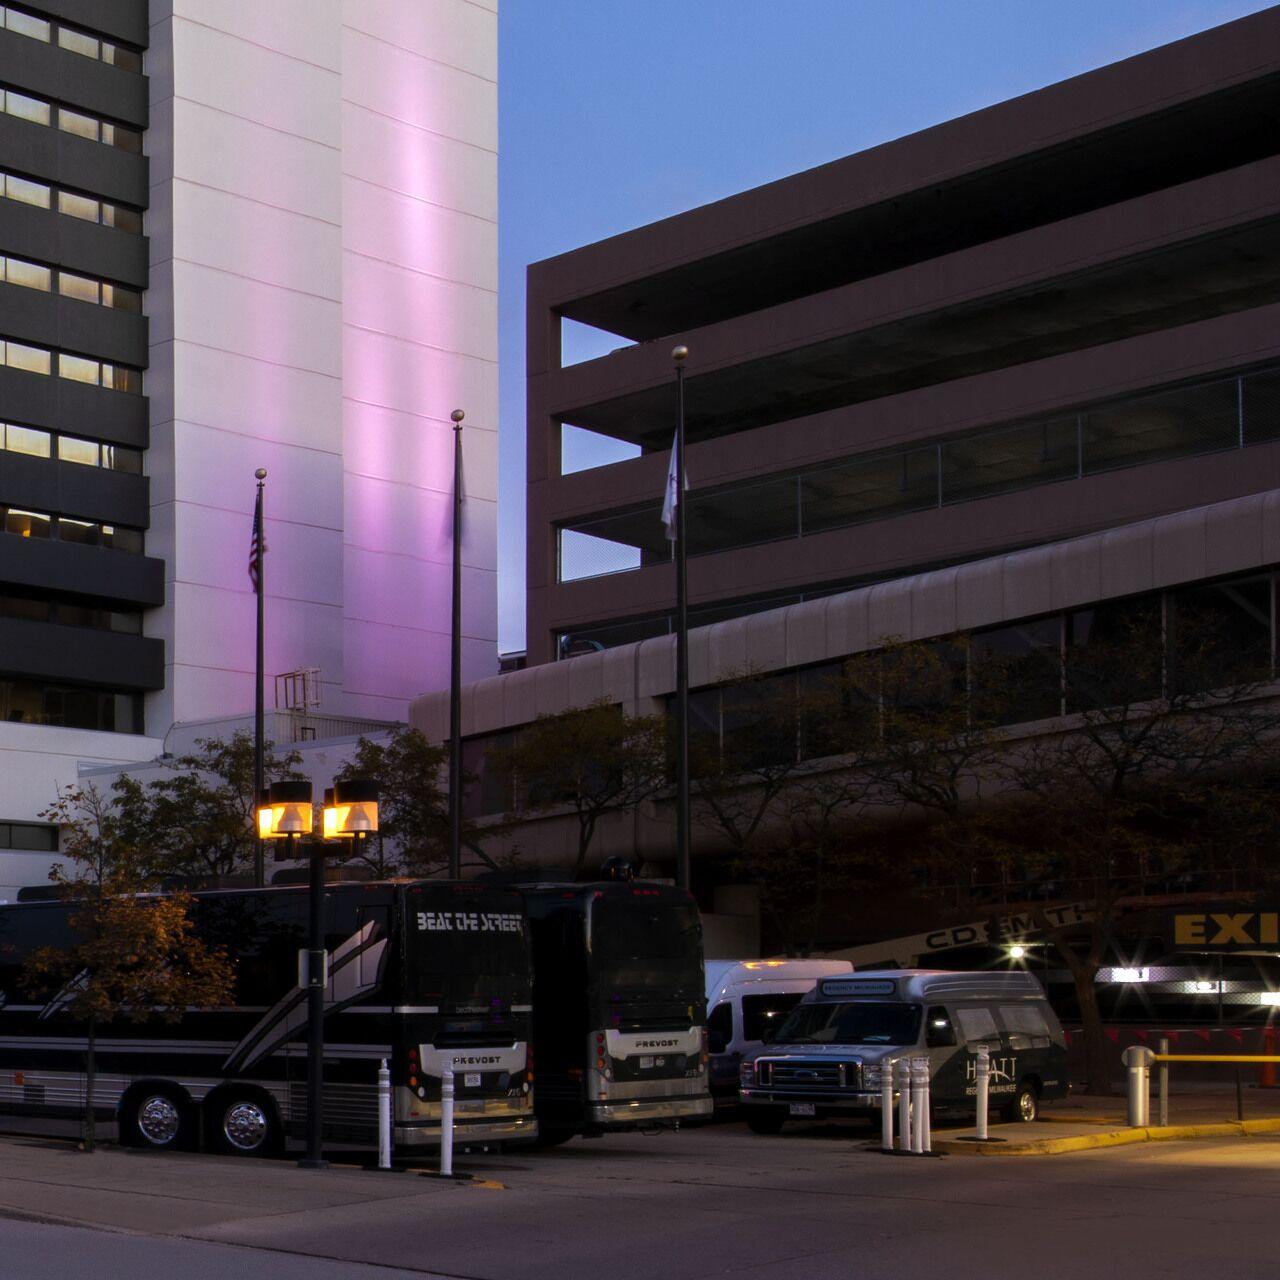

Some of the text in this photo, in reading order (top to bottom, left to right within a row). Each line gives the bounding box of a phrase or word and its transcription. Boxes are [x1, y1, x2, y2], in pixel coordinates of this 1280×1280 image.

[417, 912, 523, 932] BEAT THE STREET
[1174, 912, 1279, 945] EXI
[635, 1039, 679, 1048] PREVOST
[453, 1056, 501, 1065] PREVOST
[966, 1057, 1017, 1083] HATT
